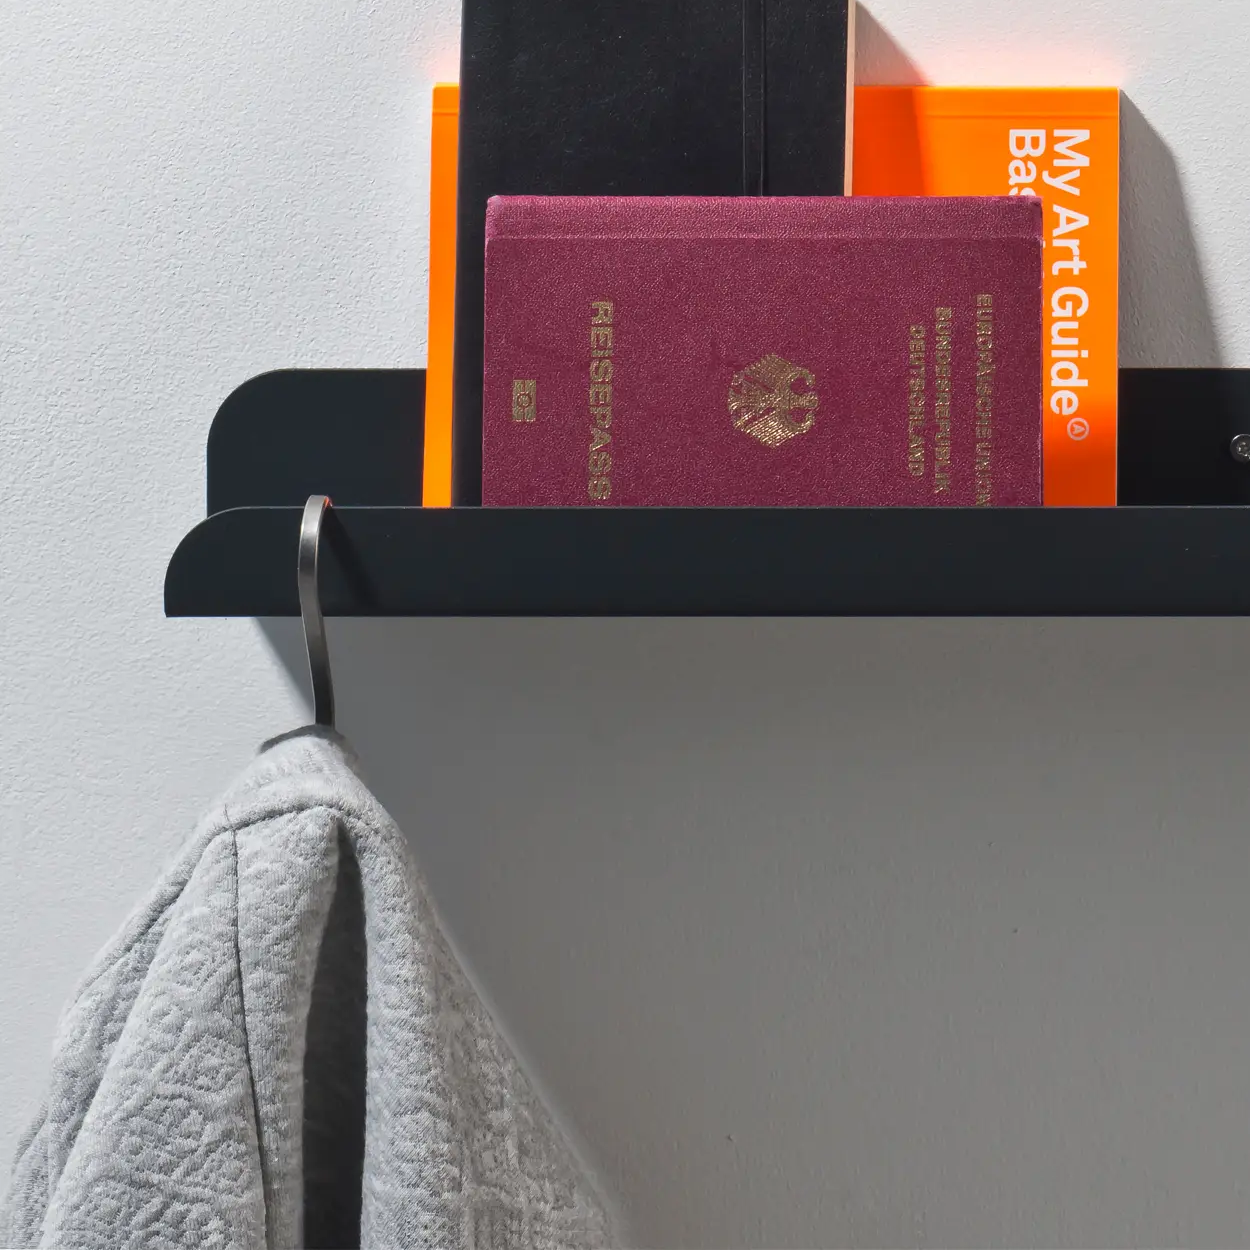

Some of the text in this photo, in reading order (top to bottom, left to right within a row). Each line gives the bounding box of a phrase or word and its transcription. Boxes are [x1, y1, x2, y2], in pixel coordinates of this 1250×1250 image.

[1041, 128, 1091, 196] My
[1051, 204, 1090, 276] Art
[588, 300, 614, 500] REISEPASS
[908, 324, 926, 477] DEUTSCHLAND
[934, 306, 952, 494] BUNDESREPUBLIK
[1050, 286, 1090, 416] Guide
